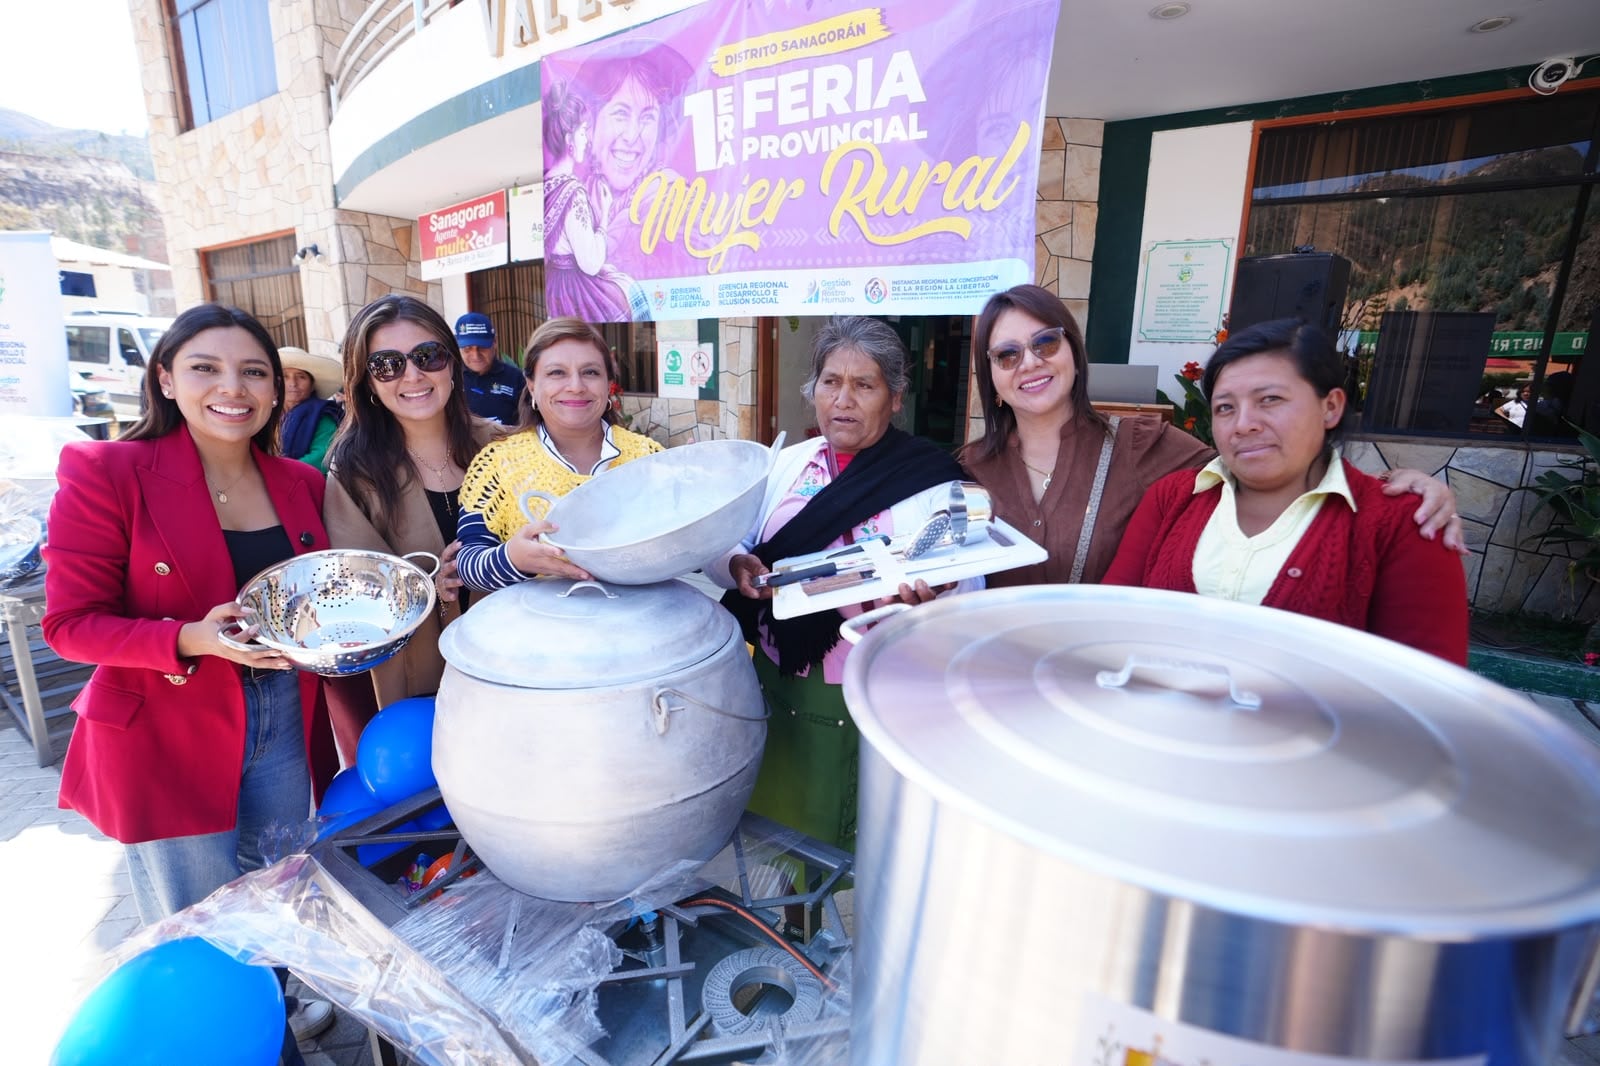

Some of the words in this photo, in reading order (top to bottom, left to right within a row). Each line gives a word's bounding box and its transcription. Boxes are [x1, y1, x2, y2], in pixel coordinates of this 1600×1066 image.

[725, 43, 778, 66] DISTRITO
[781, 22, 867, 52] SANAGORÁN
[743, 49, 927, 130] FERIA
[742, 112, 928, 161] PROVINCIAL
[629, 170, 806, 274] Mujer
[820, 120, 1031, 246] Rural
[428, 200, 495, 233] Sanagoran
[434, 228, 459, 244] Agente
[821, 278, 851, 287] Gestión
[921, 277, 948, 285] REGIONAL
[719, 283, 748, 291] GERENCIA
[749, 281, 789, 289] REGIONAL
[956, 282, 991, 290] LIBERTAD
[670, 287, 701, 295] GOBIERNO
[726, 290, 771, 298] DESARROLLO
[821, 289, 846, 297] Rostro
[670, 294, 703, 302] REGIONAL
[751, 297, 779, 305] SOCIAL
[821, 296, 855, 304] Humano
[679, 300, 711, 308] LIBERTAD
